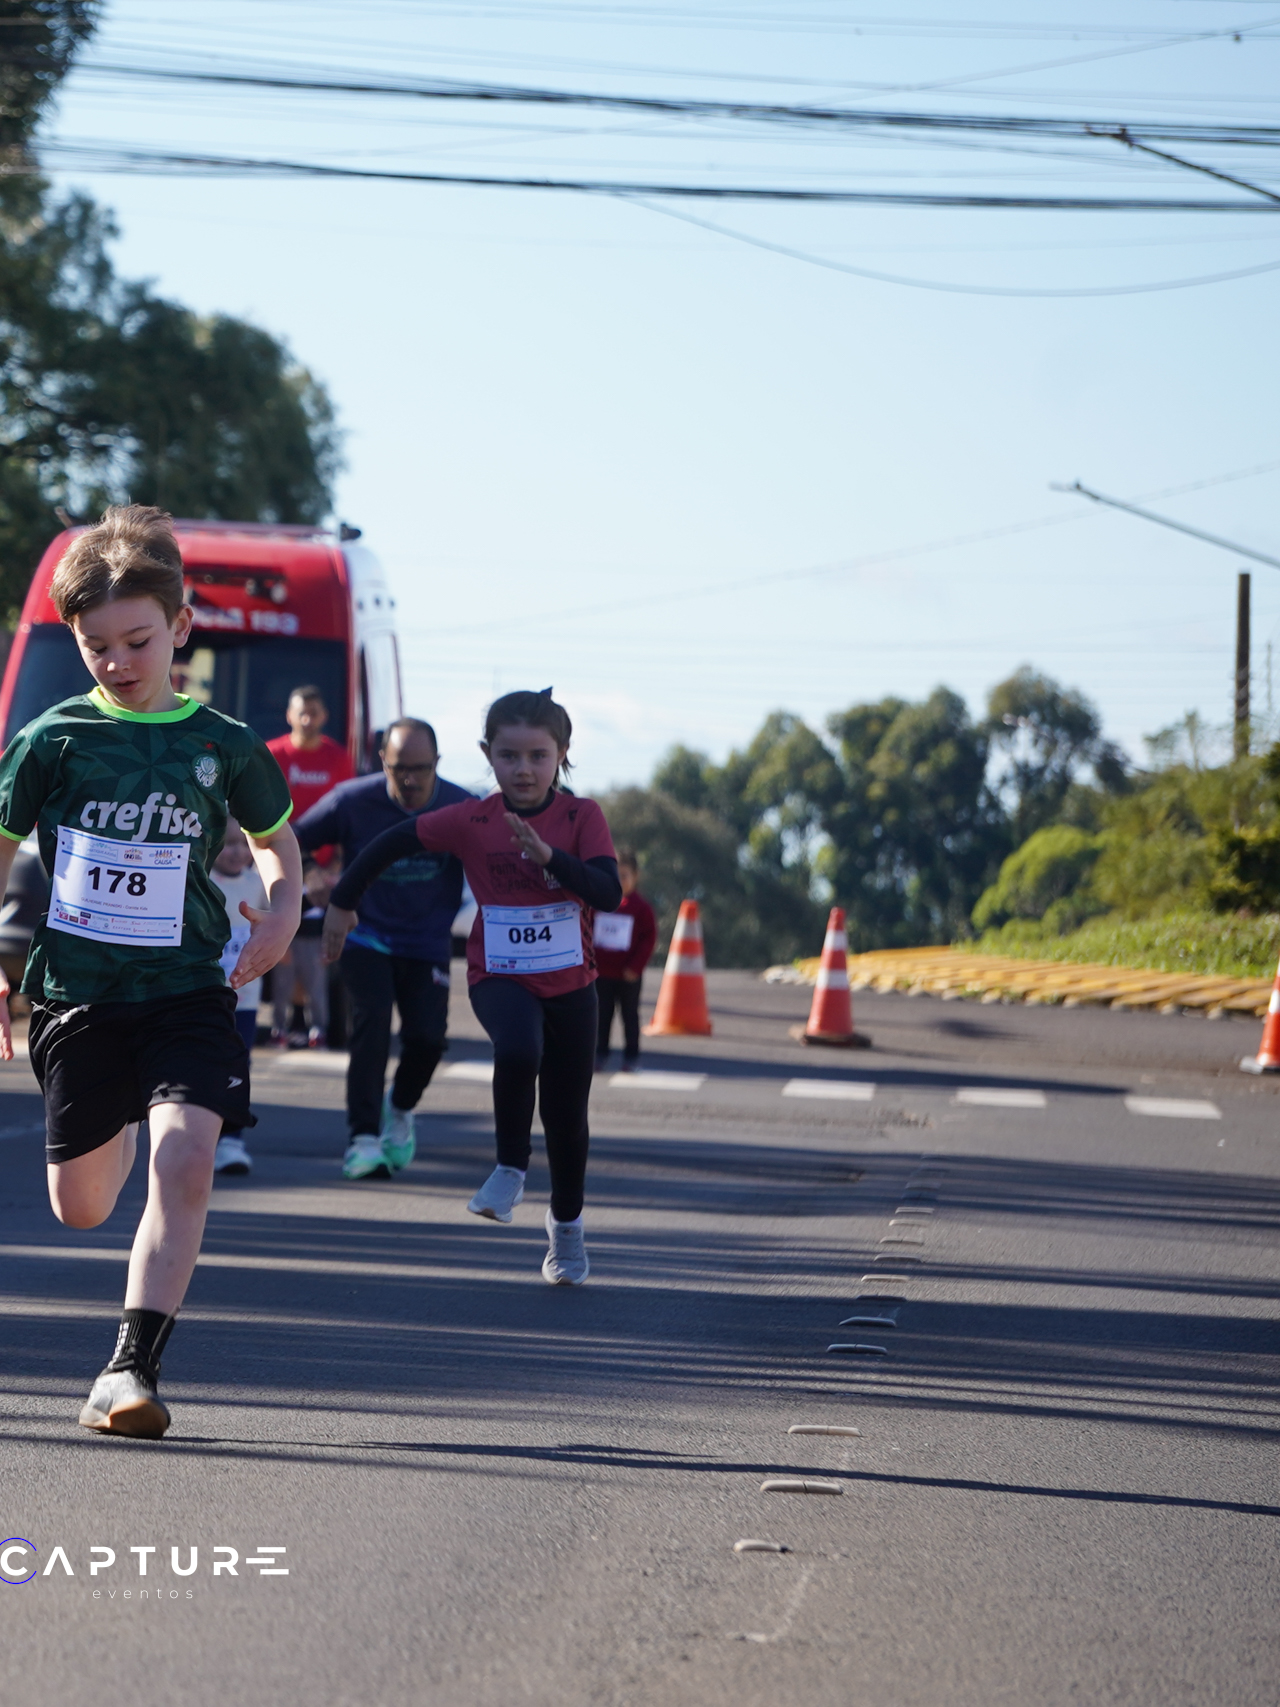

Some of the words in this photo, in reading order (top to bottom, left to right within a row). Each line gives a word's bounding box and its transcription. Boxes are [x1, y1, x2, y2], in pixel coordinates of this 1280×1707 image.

[80, 791, 204, 842] crefisa
[87, 866, 147, 897] 178
[508, 925, 552, 944] 084
